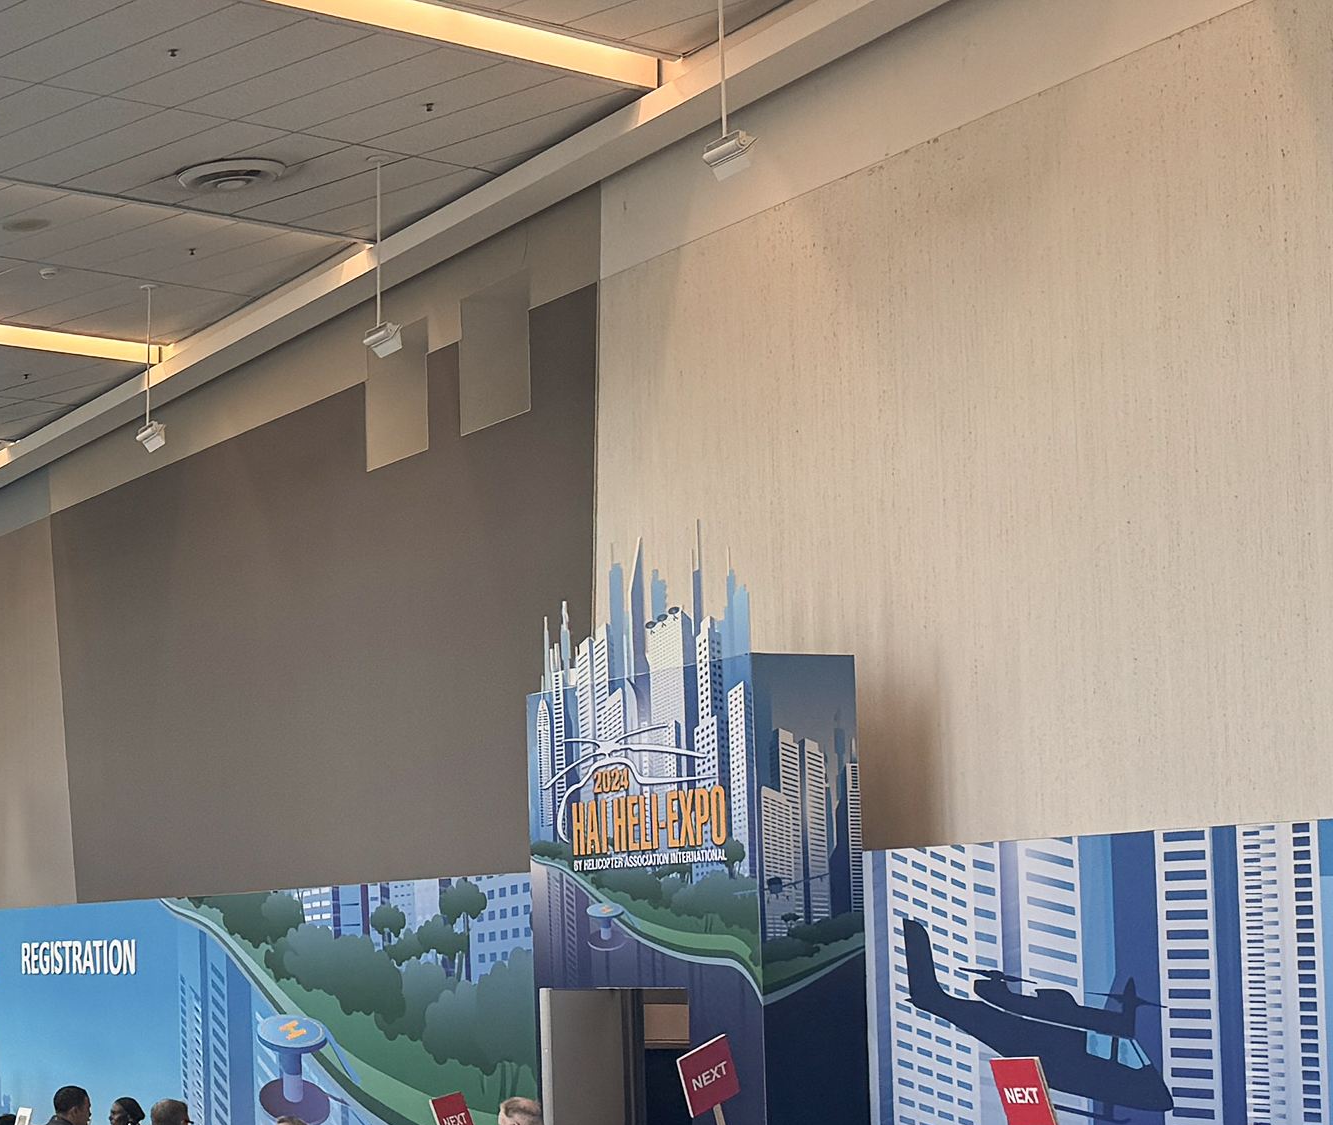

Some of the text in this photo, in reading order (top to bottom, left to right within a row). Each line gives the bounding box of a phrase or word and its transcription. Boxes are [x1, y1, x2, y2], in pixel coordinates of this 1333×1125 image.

[593, 767, 630, 794] 2024
[572, 784, 727, 856] HAI HELI-EXPO
[573, 849, 728, 872] BY HELICOPTER ASSOCIATION INTERNATIONAL
[21, 939, 136, 975] REGISTRATION
[691, 1060, 728, 1092] NEXT
[1003, 1087, 1039, 1104] NEXT
